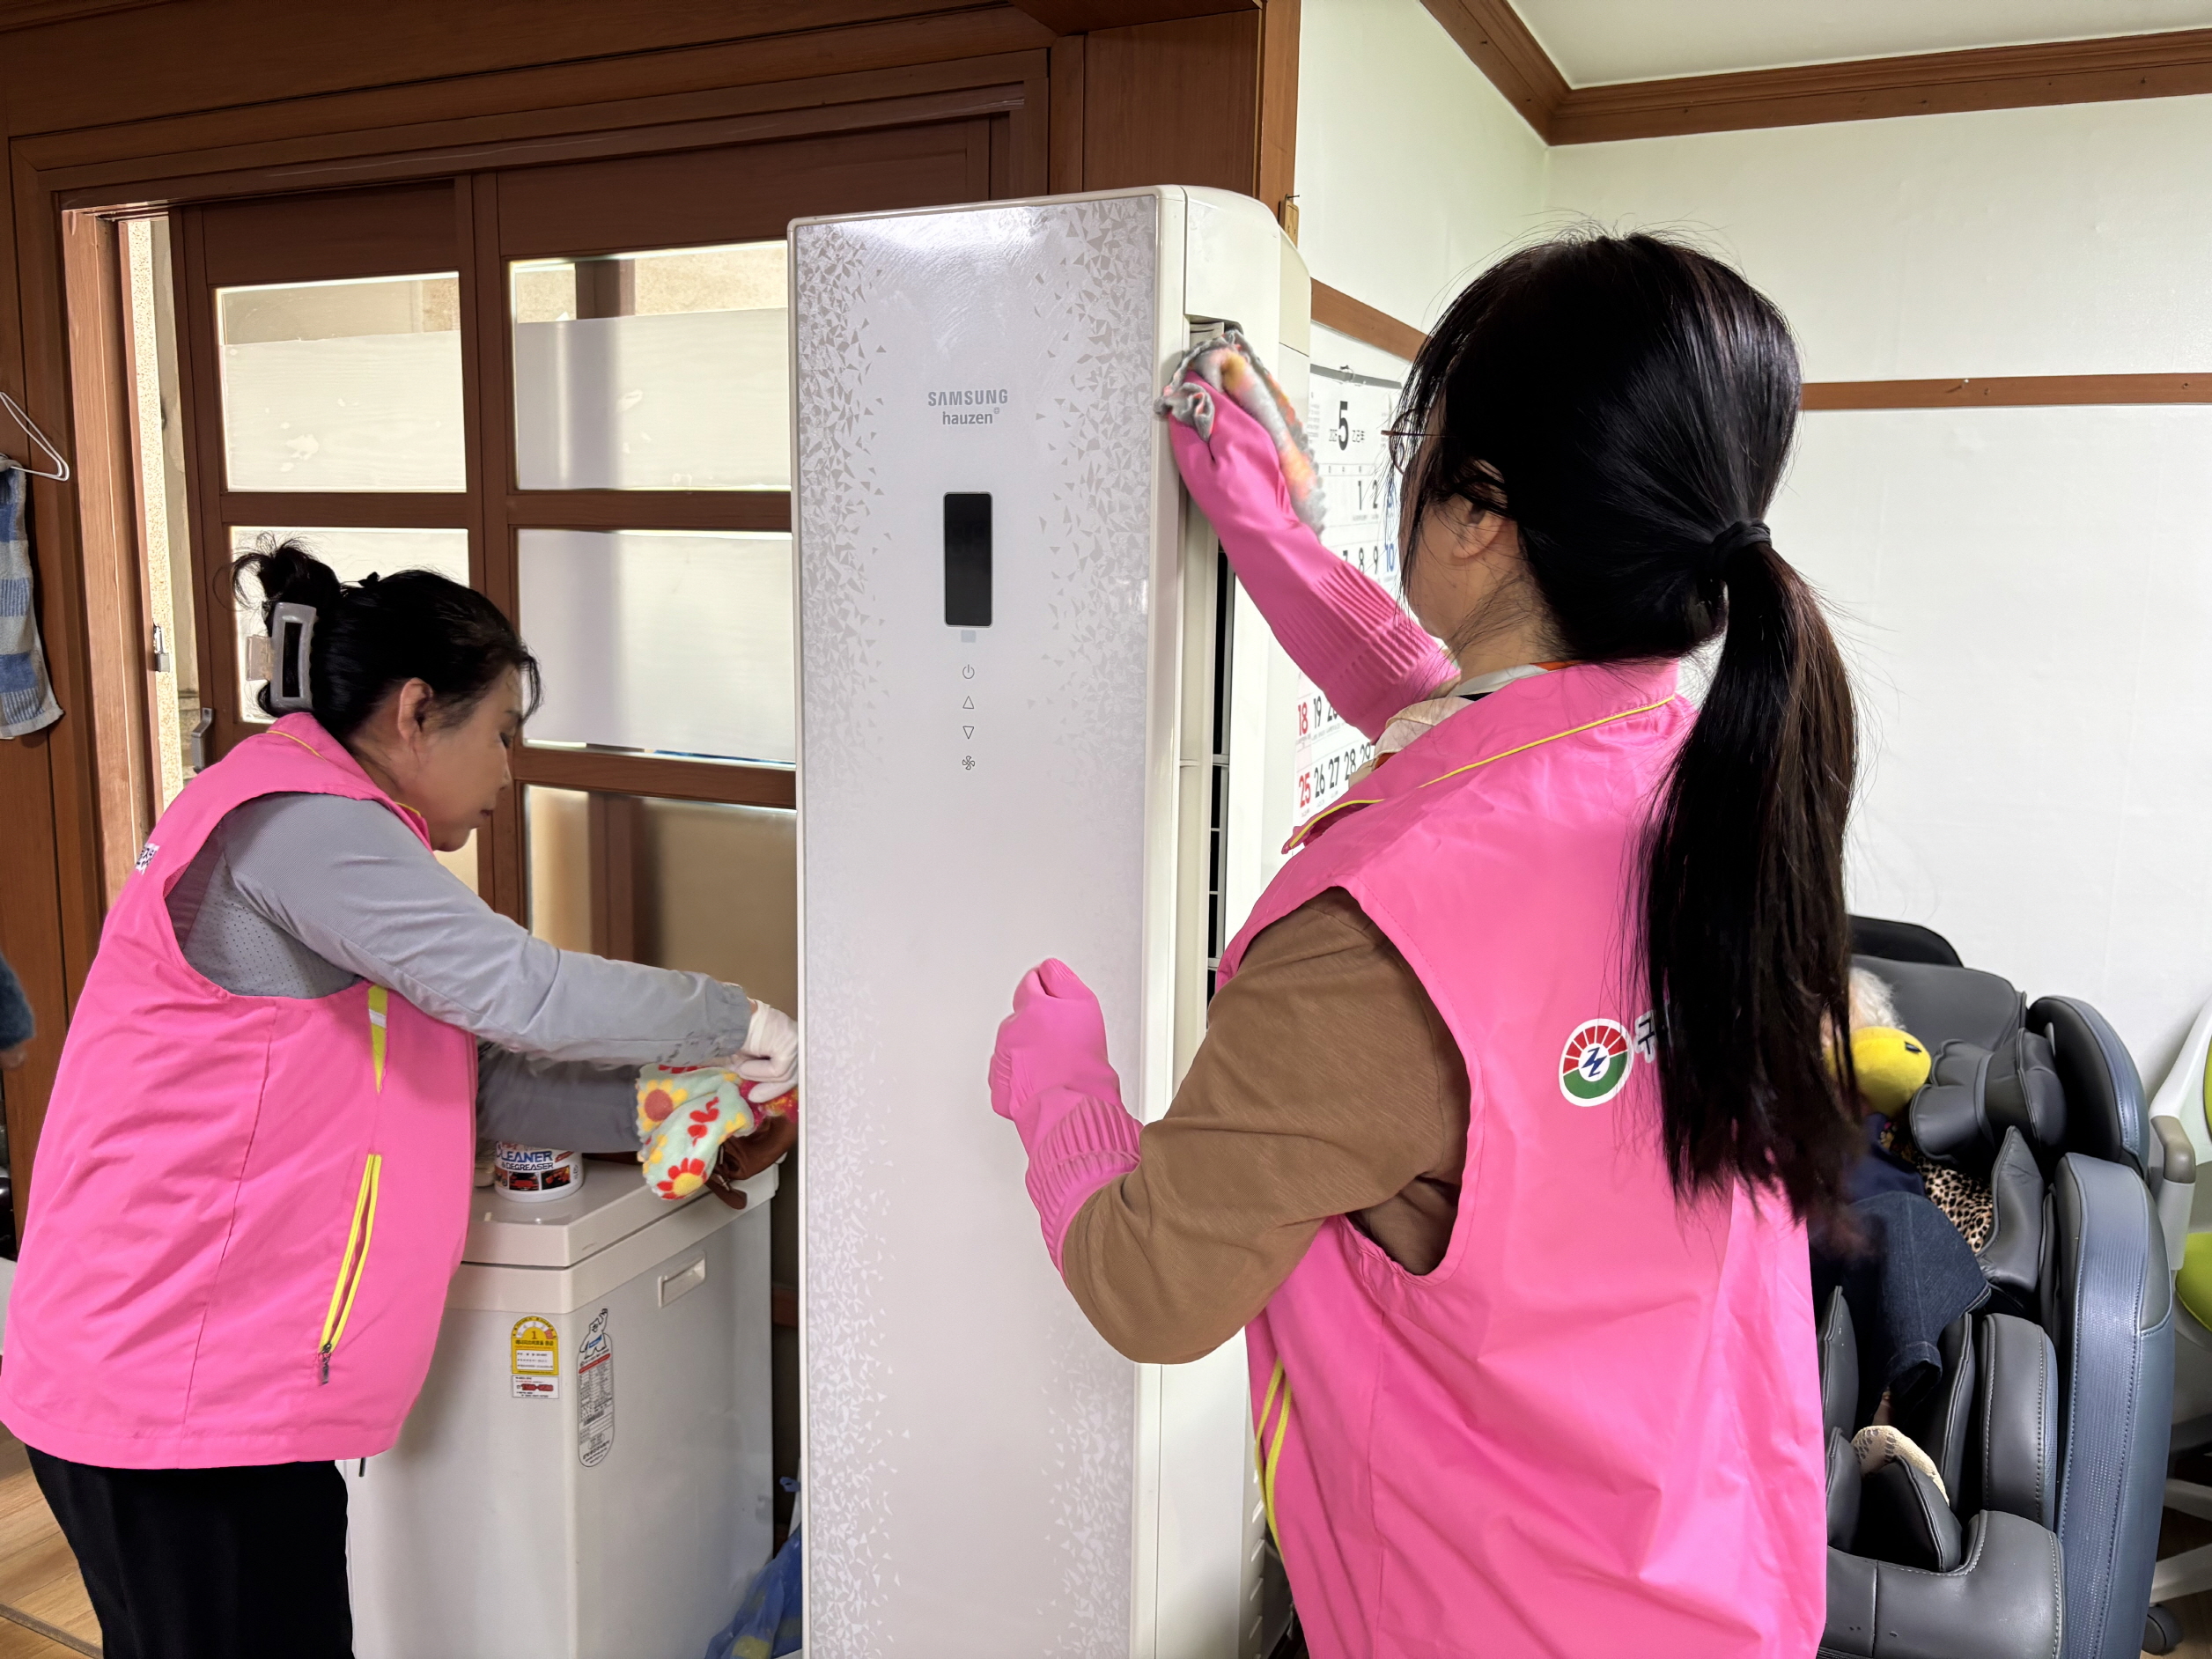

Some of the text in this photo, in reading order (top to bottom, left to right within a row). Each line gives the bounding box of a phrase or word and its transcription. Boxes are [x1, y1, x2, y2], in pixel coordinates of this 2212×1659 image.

[928, 389, 1008, 406] SAMSUNG
[942, 411, 993, 424] hauzen
[1338, 401, 1349, 450] 5
[1358, 481, 1362, 510] 1
[1372, 479, 1378, 509] 2
[1373, 545, 1378, 574] 9
[1385, 542, 1395, 572] 10
[1298, 702, 1309, 736] 18
[1313, 696, 1322, 729] 19
[1299, 771, 1311, 808] 25
[1314, 763, 1325, 799] 26
[1328, 756, 1340, 789] 27
[1344, 748, 1356, 781] 28
